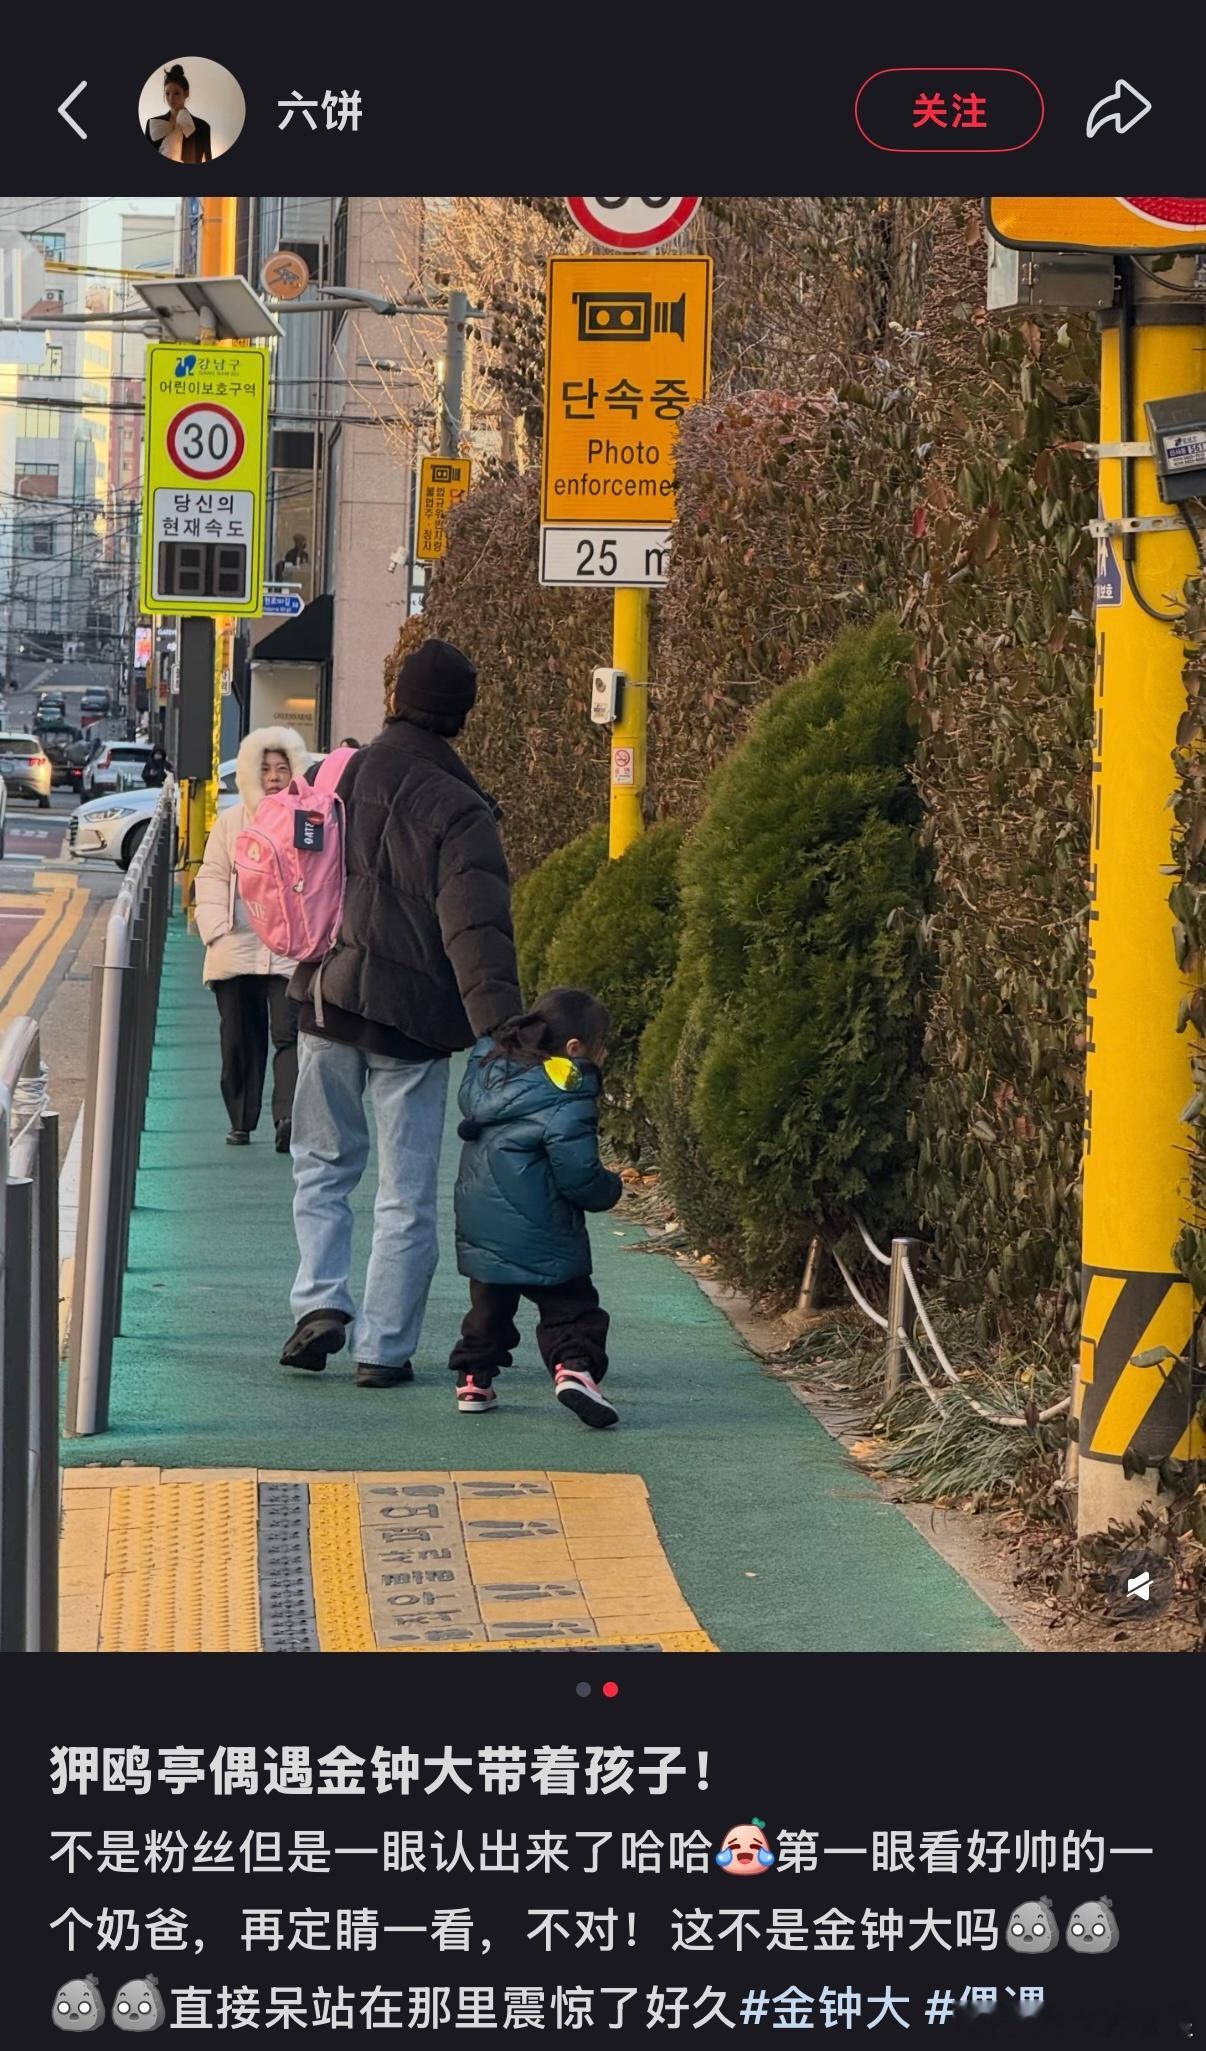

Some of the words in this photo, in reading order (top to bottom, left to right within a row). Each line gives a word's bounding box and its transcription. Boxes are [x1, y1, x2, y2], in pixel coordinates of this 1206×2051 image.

[198, 358, 240, 371] 강남구
[160, 380, 256, 397] 어린이보호구역
[562, 377, 690, 421] 단속중
[183, 422, 229, 460] 30
[588, 439, 660, 465] Photo
[554, 473, 678, 497] enforceme
[174, 493, 234, 515] 당신의
[162, 517, 245, 538] 현재속도
[576, 539, 618, 576] 25
